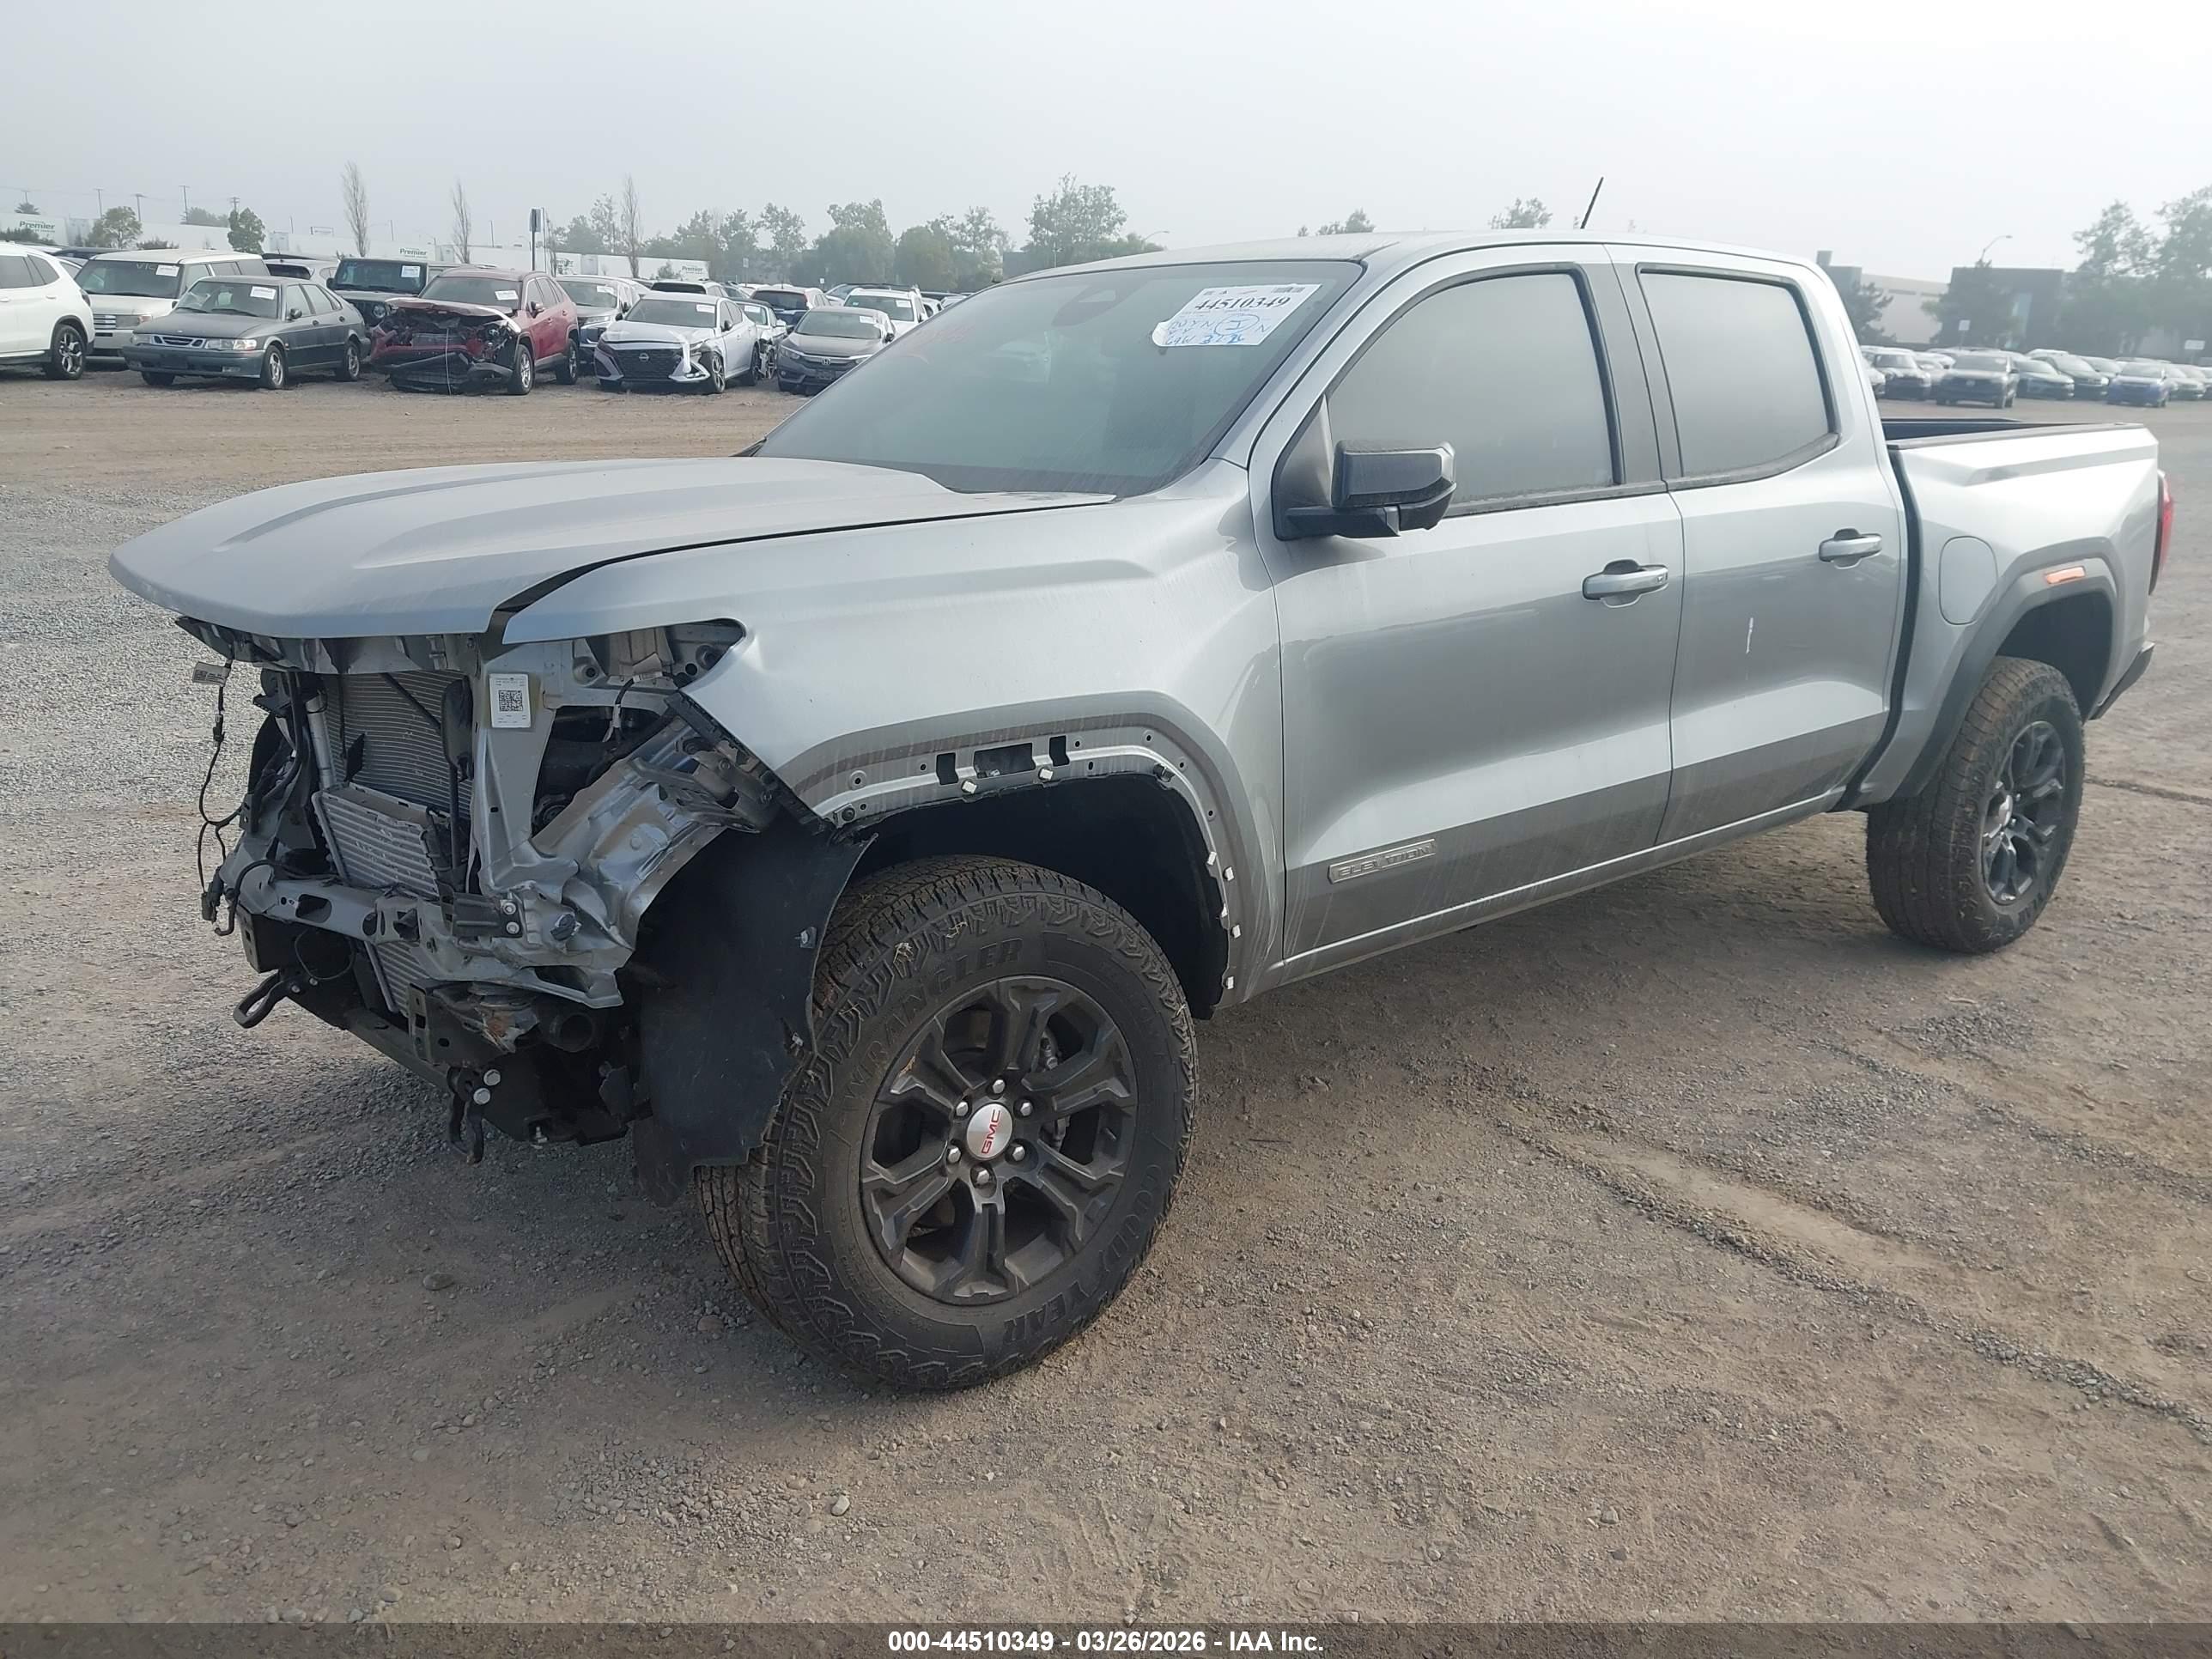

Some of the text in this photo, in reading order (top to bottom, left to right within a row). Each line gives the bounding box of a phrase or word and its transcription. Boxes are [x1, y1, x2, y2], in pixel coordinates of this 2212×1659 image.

[19, 220, 55, 230] Premier
[399, 247, 428, 256] Premier
[1194, 295, 1291, 311] 44510349
[843, 936, 1024, 1103] WRANGLER
[981, 1109, 1001, 1155] GMC
[1002, 1162, 1164, 1344] GOODYEAR
